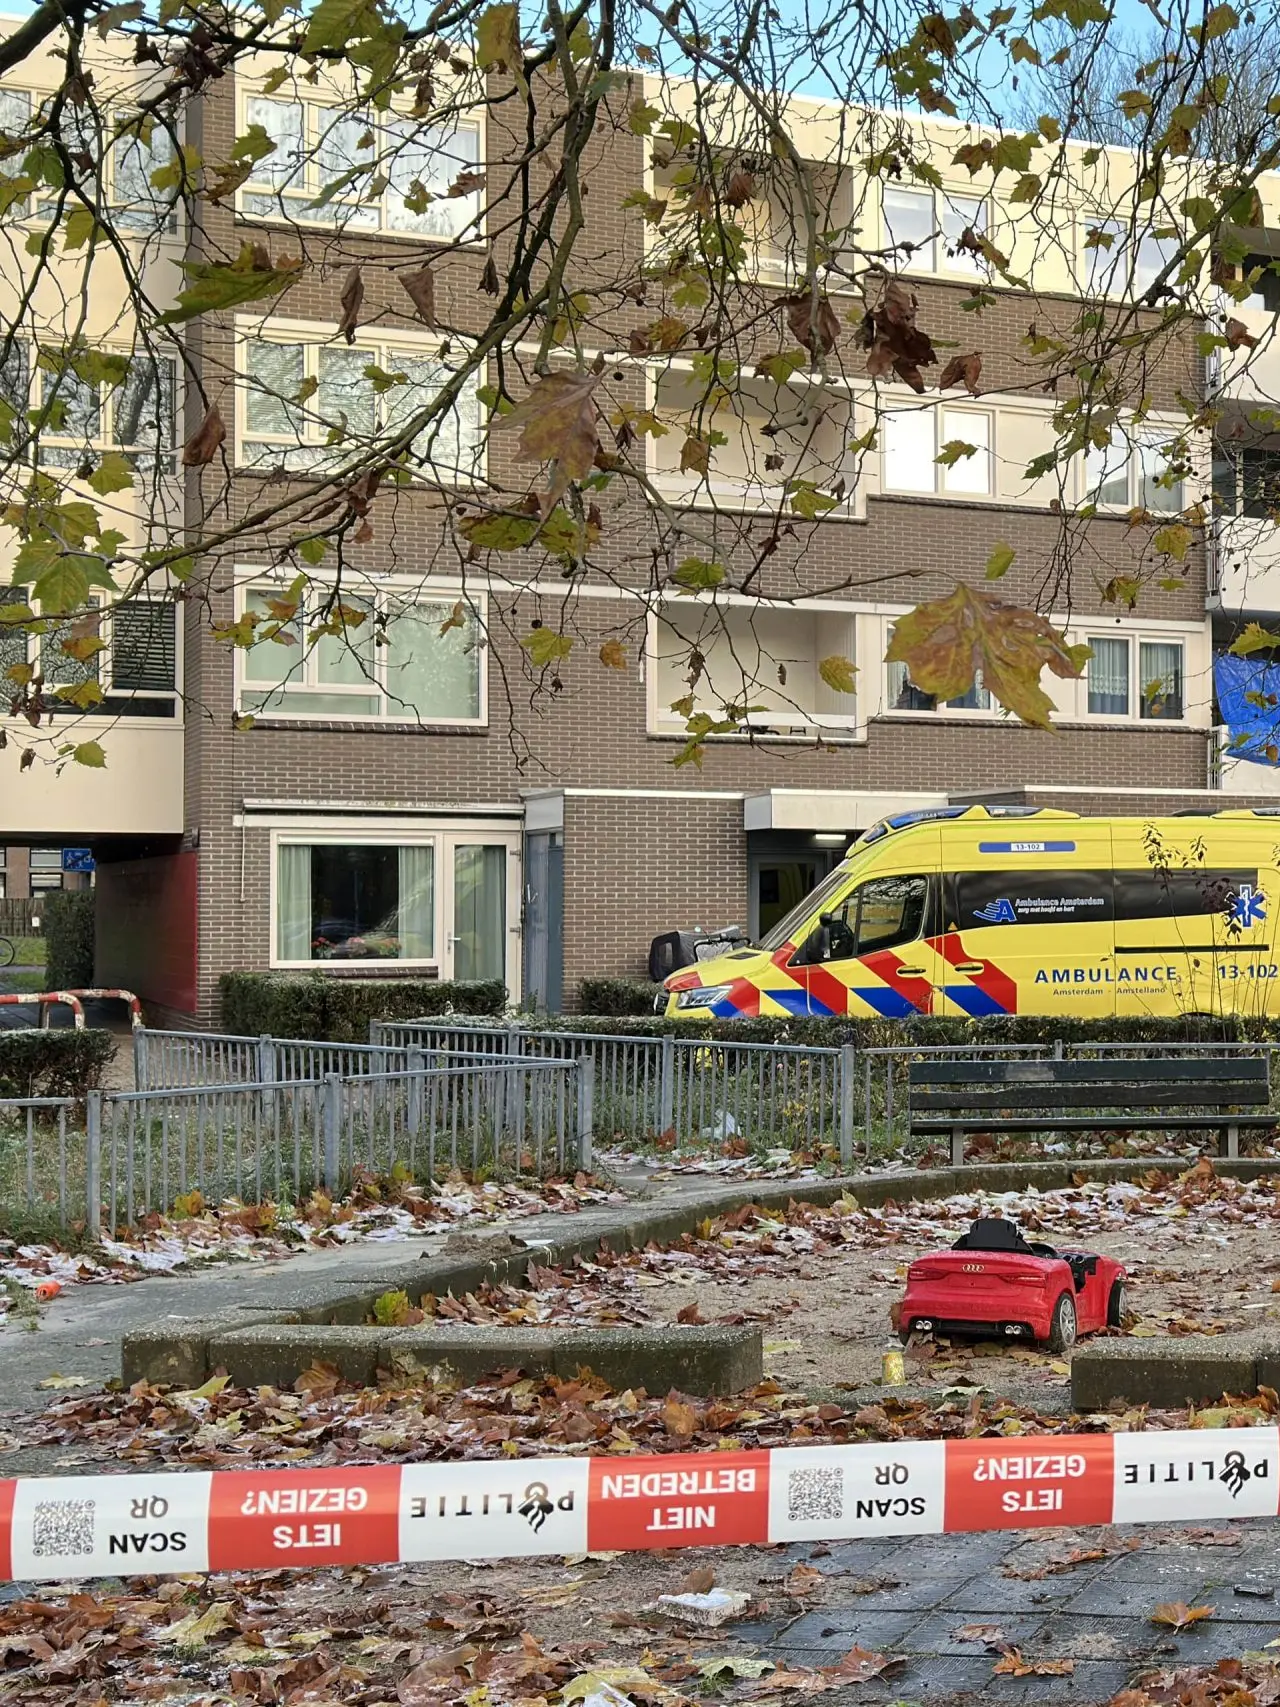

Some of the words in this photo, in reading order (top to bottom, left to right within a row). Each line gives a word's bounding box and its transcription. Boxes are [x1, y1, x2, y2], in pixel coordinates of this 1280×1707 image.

[1016, 843, 1040, 851] 13-102
[1015, 897, 1059, 907] Ambulance
[1060, 896, 1104, 906] Amsterdam
[1034, 966, 1177, 984] AMBULANCE
[1218, 964, 1279, 979] 13-102
[1053, 988, 1104, 996] Amsterdam
[1116, 985, 1166, 995] Amstelland
[874, 1462, 909, 1486] QR
[973, 1454, 1086, 1482] GEZIEN?
[601, 1468, 756, 1499] BETREDEN
[130, 1495, 168, 1519] QR
[240, 1487, 367, 1515] GEZIEN?
[856, 1498, 926, 1518] SCAN
[1002, 1489, 1063, 1513] IETS
[646, 1506, 715, 1531] NIET
[109, 1532, 187, 1554] SCAN
[273, 1524, 341, 1549] IETS
